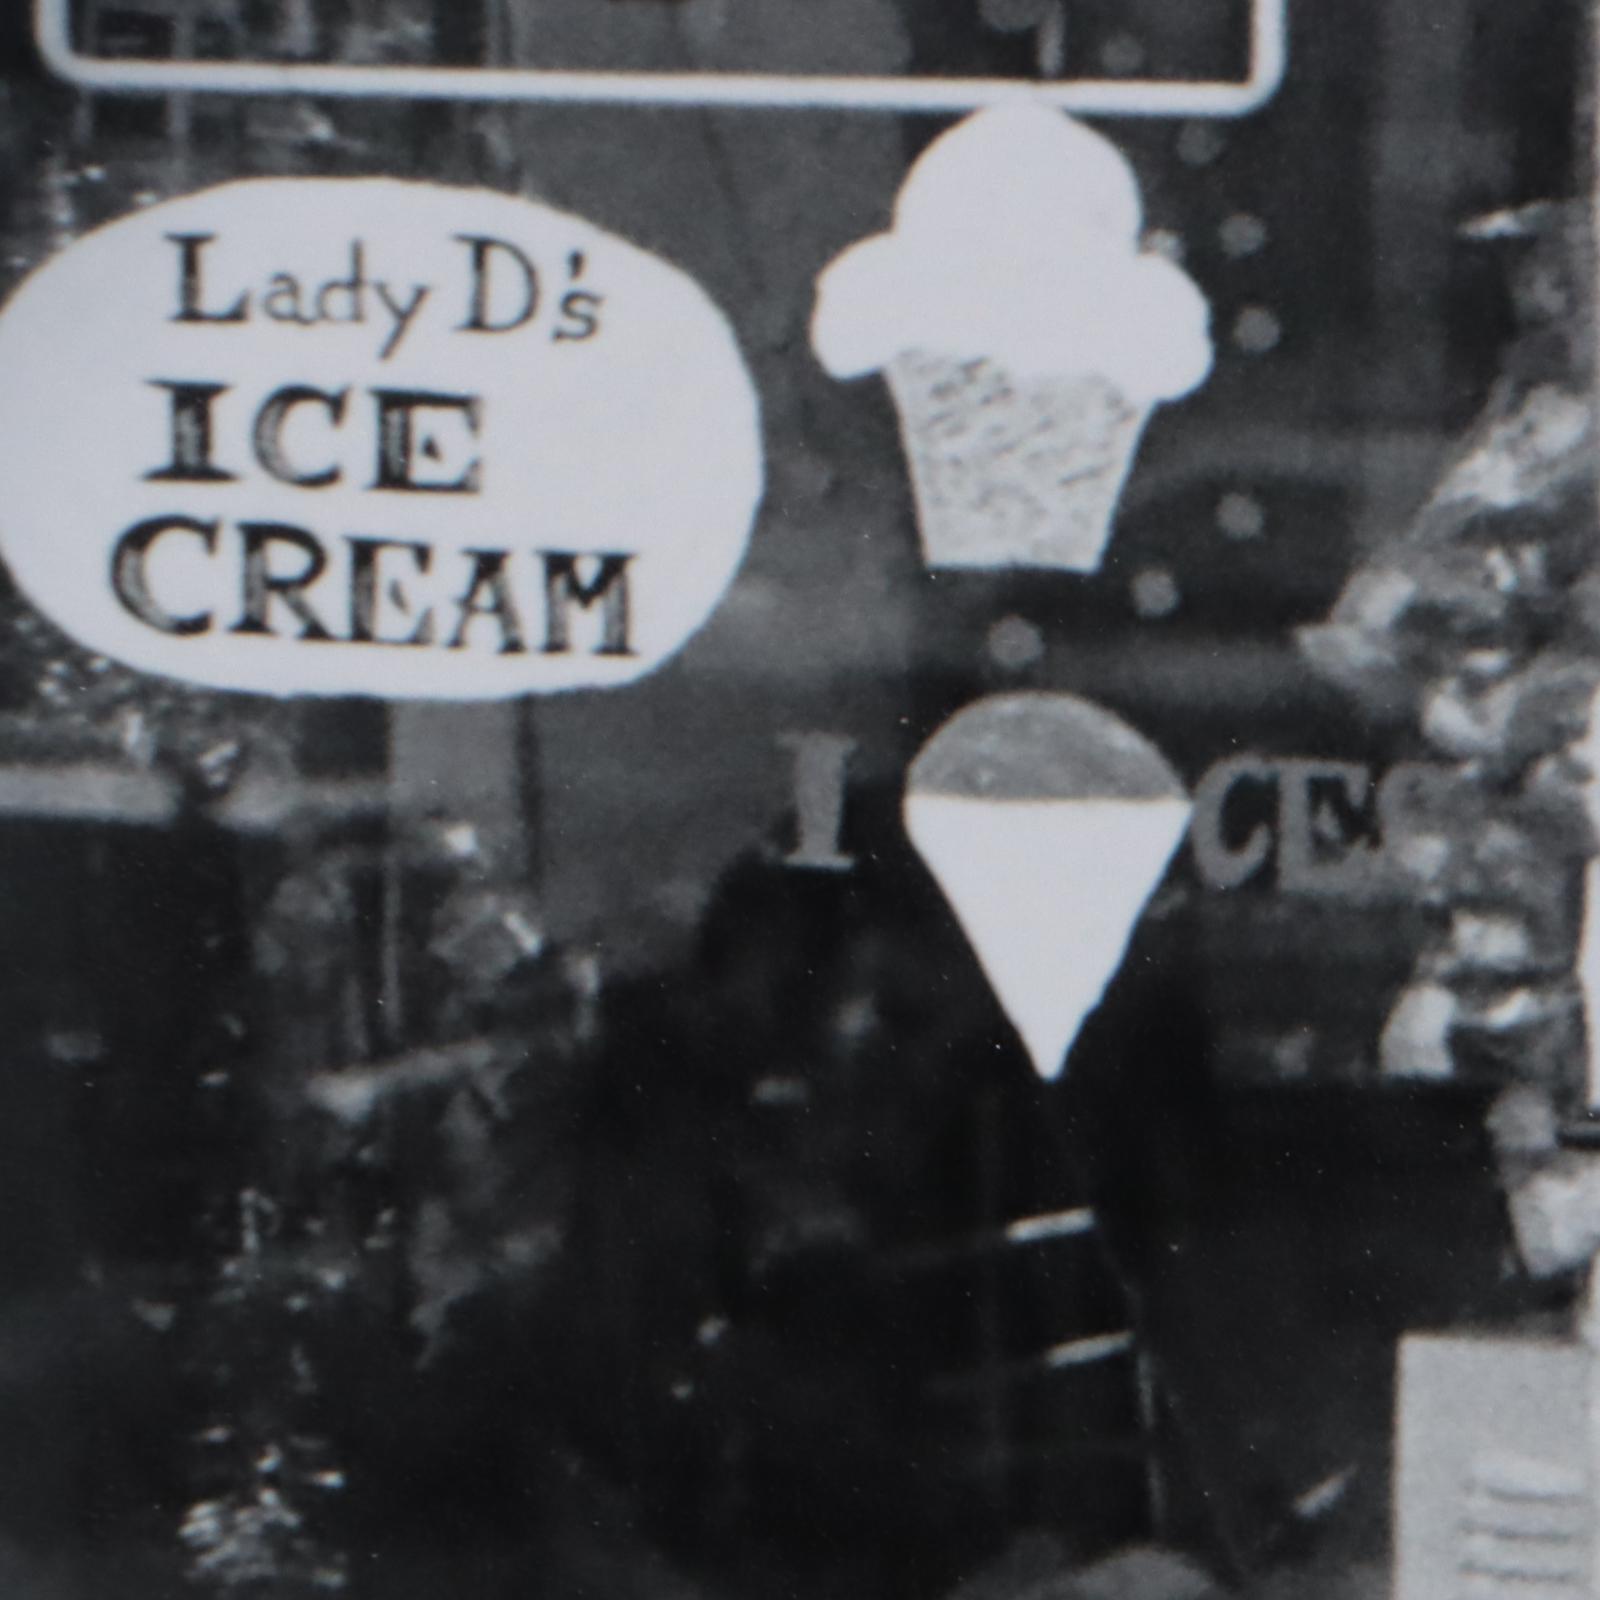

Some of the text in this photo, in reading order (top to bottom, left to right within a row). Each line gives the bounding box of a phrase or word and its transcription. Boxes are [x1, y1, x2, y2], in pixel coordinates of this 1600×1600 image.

[163, 232, 604, 360] Lady D's
[140, 380, 484, 494] ICE
[109, 514, 640, 658] CREAM
